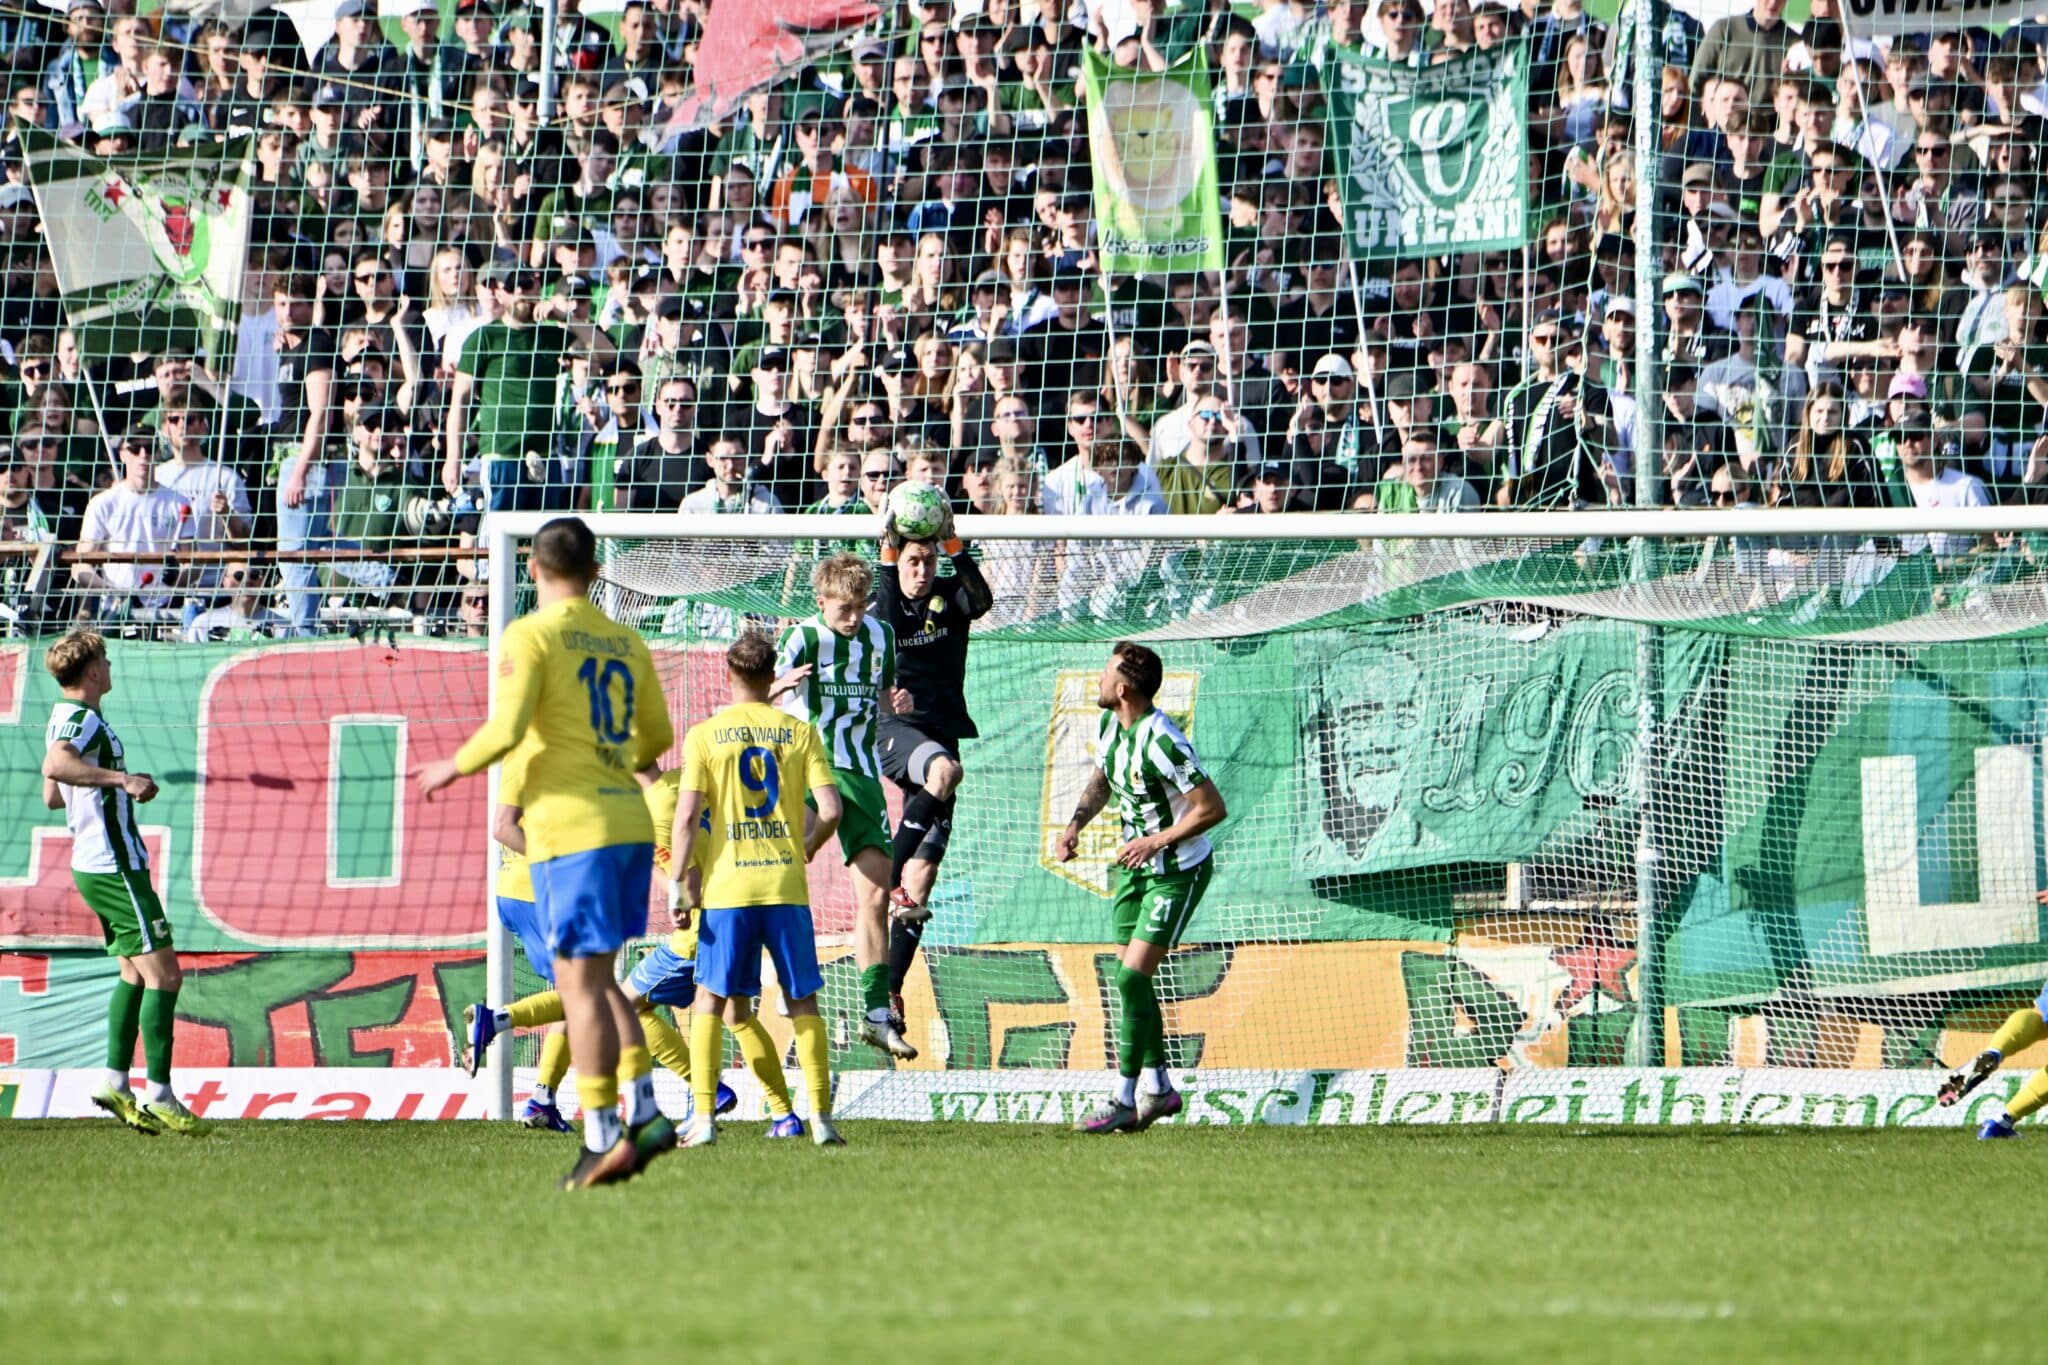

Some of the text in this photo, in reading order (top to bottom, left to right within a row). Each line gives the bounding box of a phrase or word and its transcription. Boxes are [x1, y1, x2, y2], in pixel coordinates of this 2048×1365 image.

[1354, 199, 1521, 248] UMLAND
[576, 656, 635, 744] 10
[714, 726, 793, 744] LUCKENWALDE
[738, 745, 779, 818] 9
[1149, 895, 1172, 922] 21
